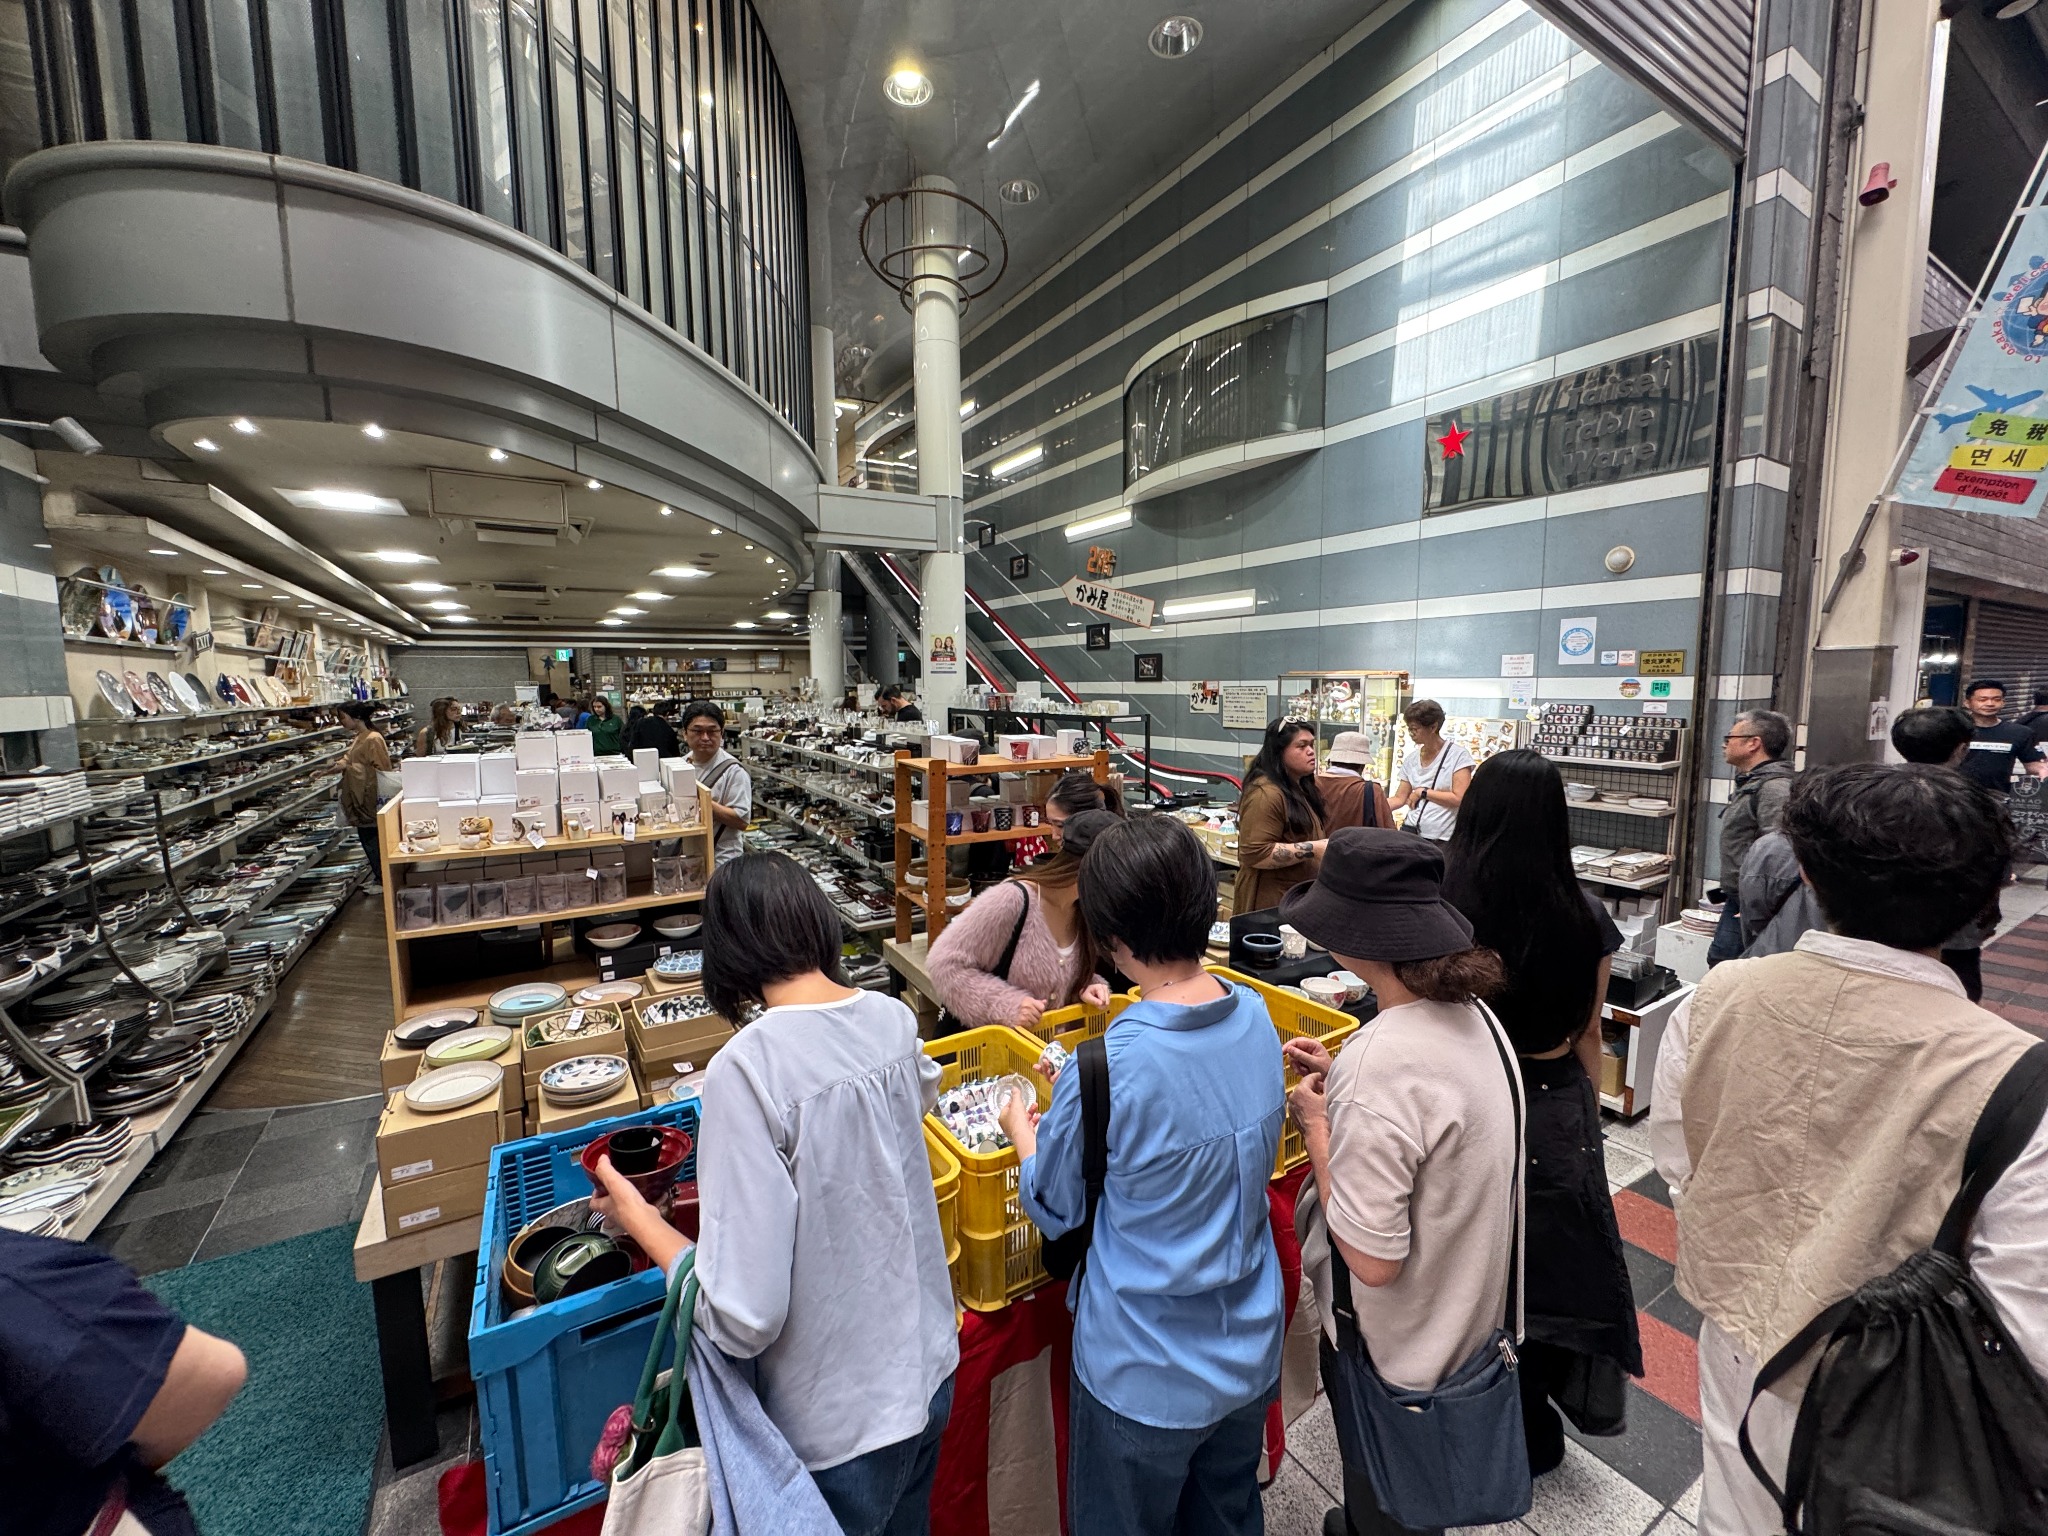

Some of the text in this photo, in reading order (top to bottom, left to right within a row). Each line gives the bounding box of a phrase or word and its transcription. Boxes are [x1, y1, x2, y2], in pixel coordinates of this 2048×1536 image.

[1991, 320, 2016, 355] osaka
[1568, 360, 1671, 411] Taisei
[1565, 406, 1655, 444] Table
[1563, 442, 1656, 477] Ware
[1969, 448, 2028, 467] 면세
[1954, 472, 2020, 490] Exemption
[1076, 585, 1109, 612] かみ屋
[1191, 690, 1218, 706] かみ屋
